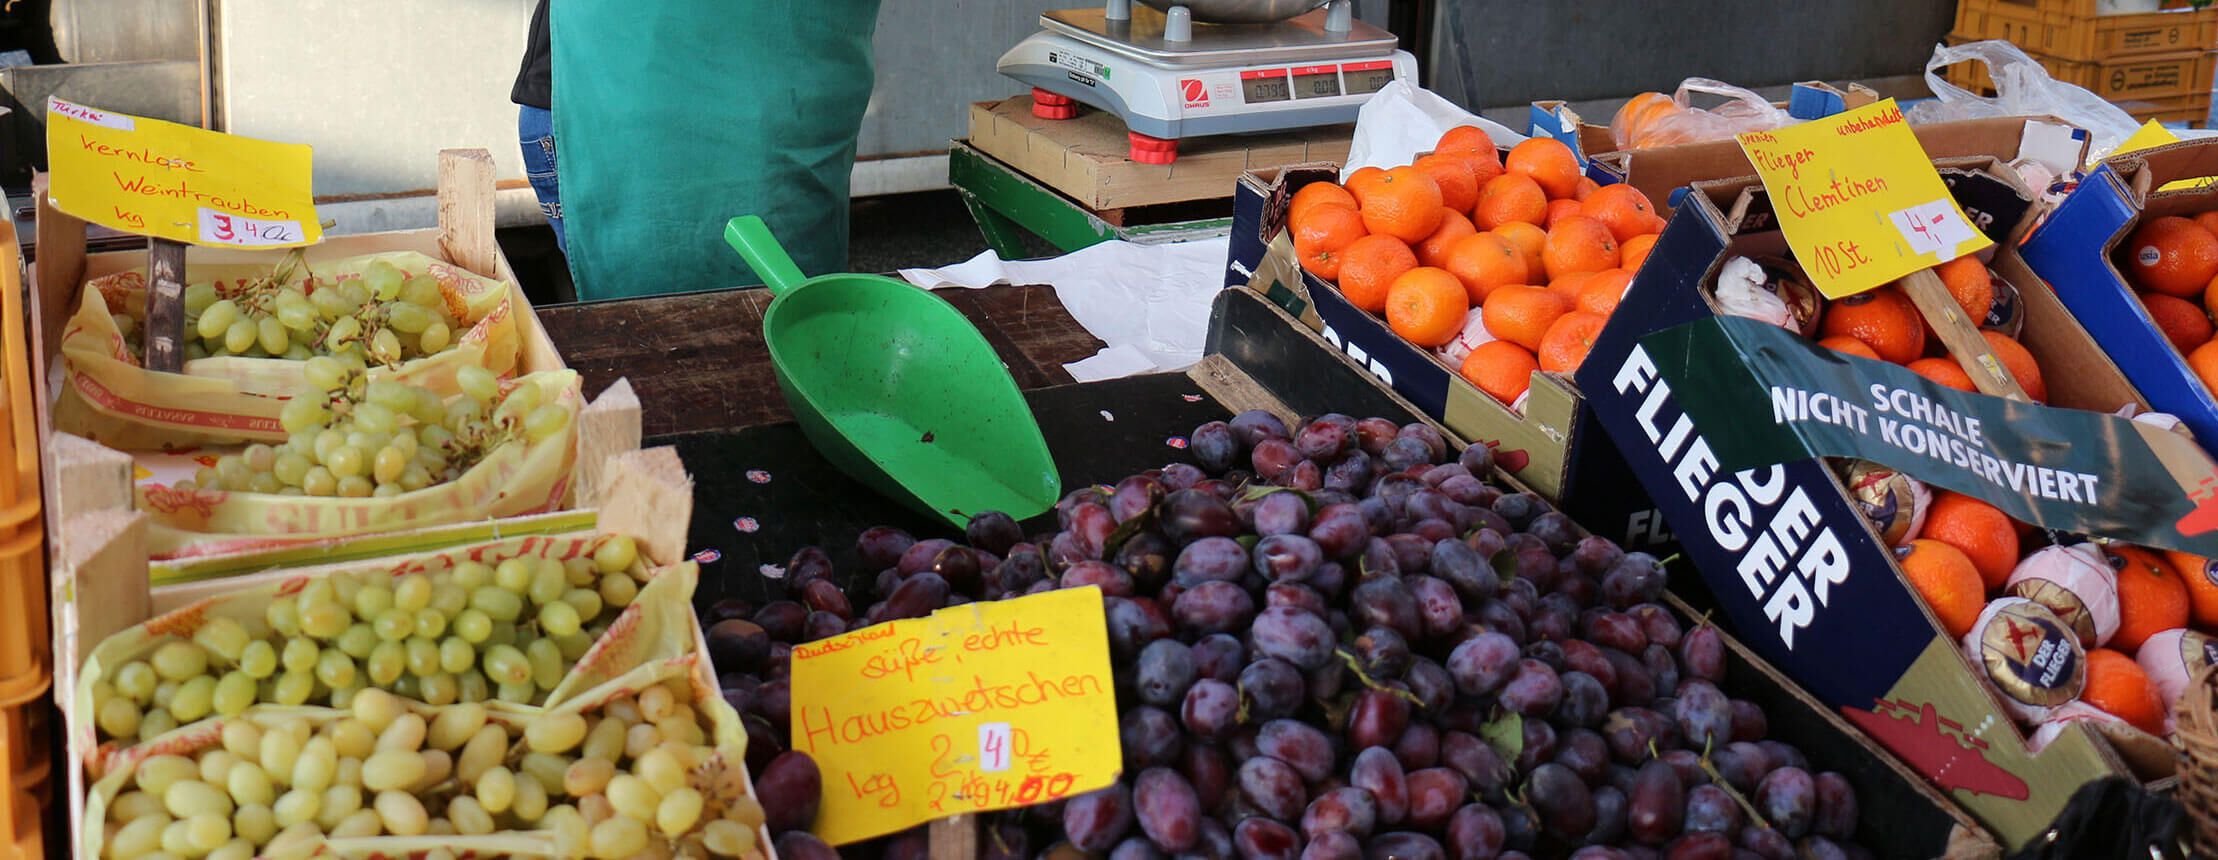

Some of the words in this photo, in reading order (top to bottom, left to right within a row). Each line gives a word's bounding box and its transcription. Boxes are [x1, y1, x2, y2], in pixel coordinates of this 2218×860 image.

[1184, 101, 1211, 110] OHAUS
[1836, 107, 1903, 136] unbehandelt
[1753, 147, 1815, 180] Flieger
[113, 171, 289, 219] Weintrauben
[1813, 242, 1842, 280] 10
[1870, 383, 1982, 447] SCHALE
[1771, 385, 1868, 436] NICHT
[1878, 415, 2098, 506] KONSERVIERT
[1611, 342, 1815, 651] FLIEGER
[963, 620, 1049, 652] echte
[2032, 638, 2056, 668] DER
[2039, 638, 2071, 688] FLIEGER
[800, 670, 1103, 754] Hauszwetschen
